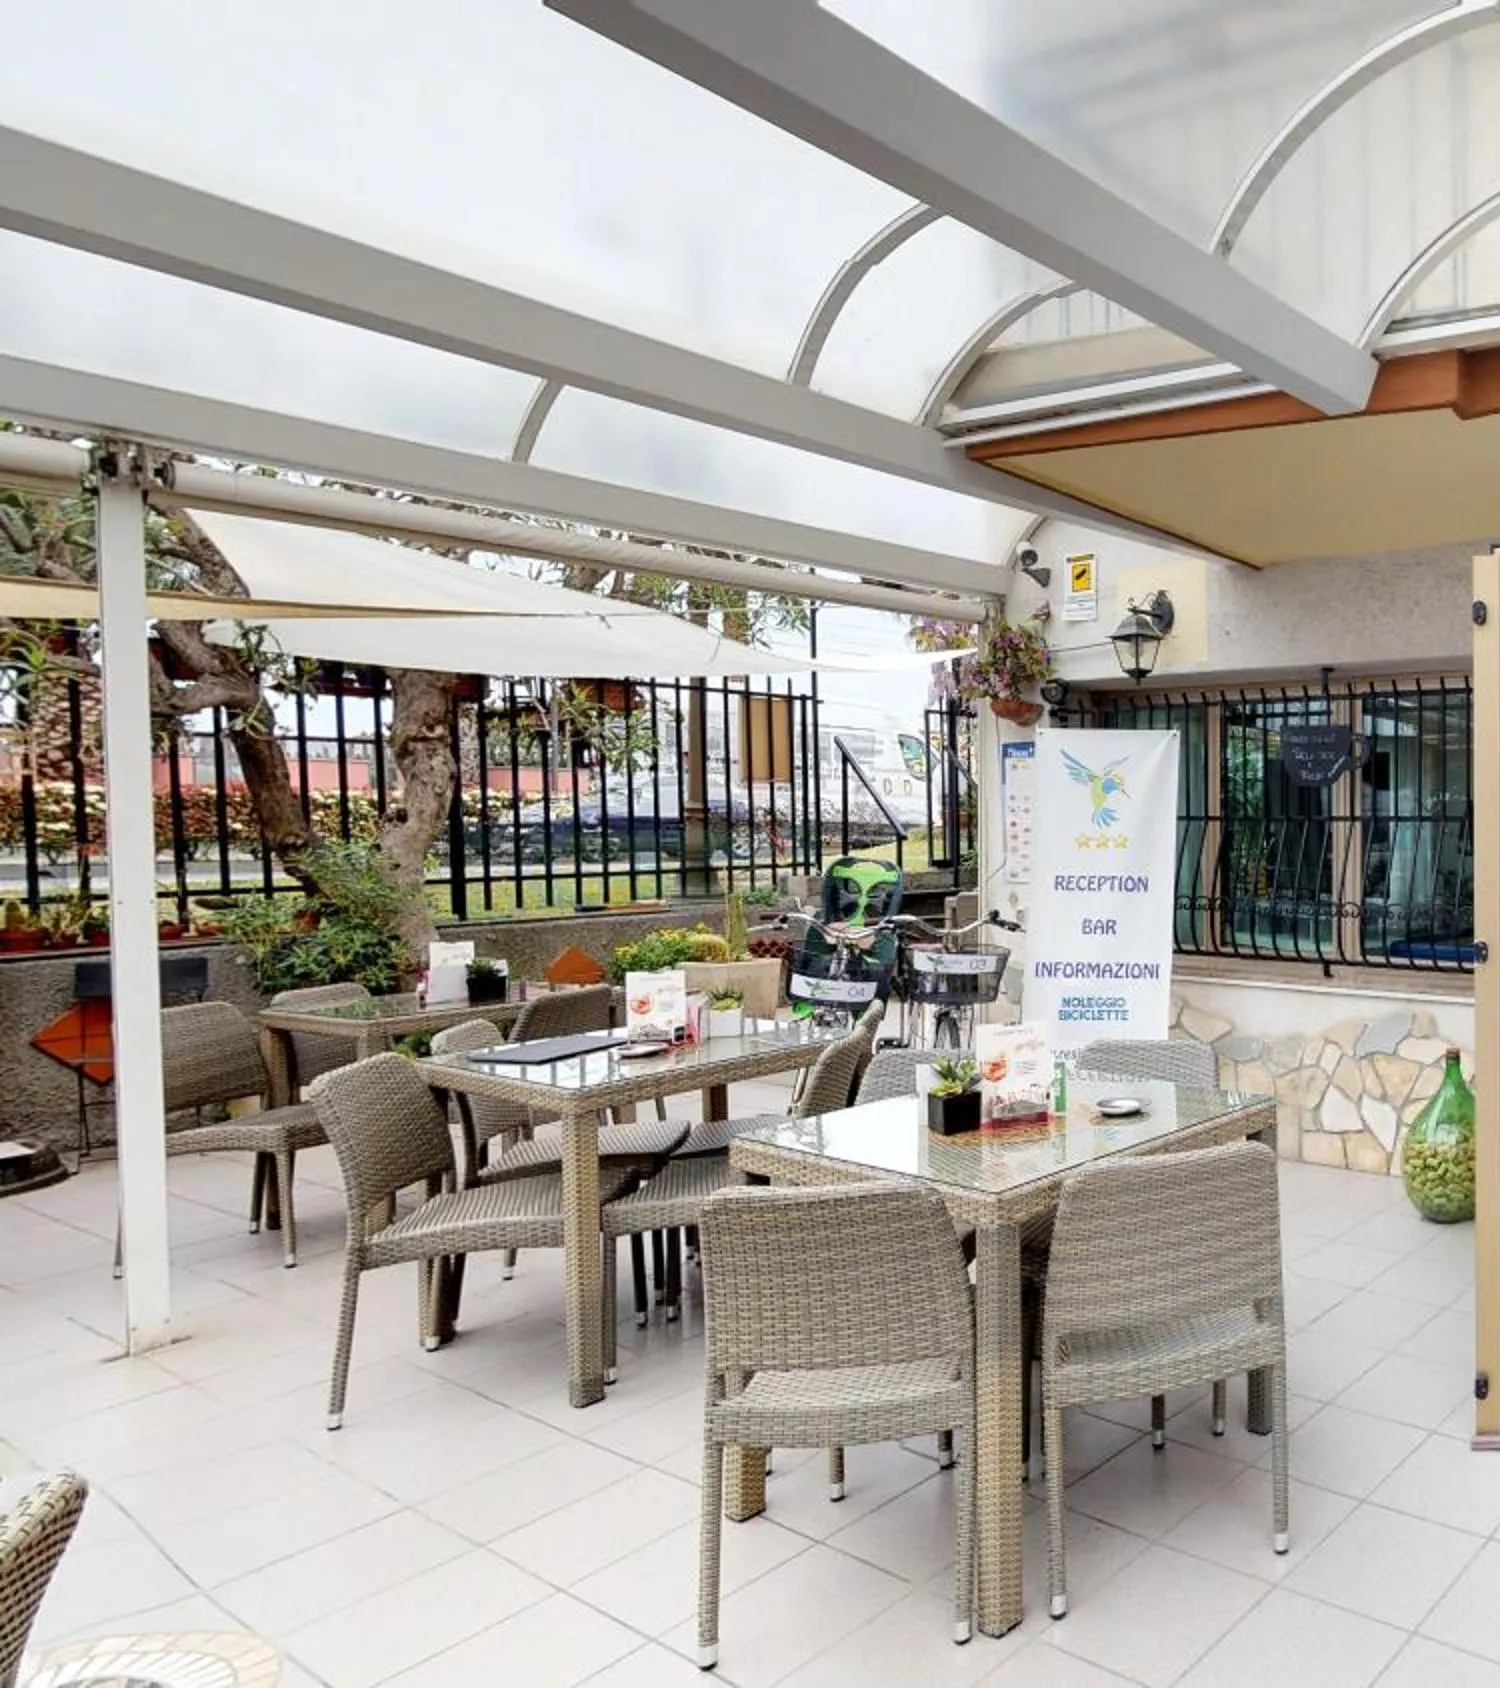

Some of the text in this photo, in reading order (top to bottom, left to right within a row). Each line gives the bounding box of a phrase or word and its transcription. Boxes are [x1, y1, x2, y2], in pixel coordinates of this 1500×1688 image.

[1054, 875, 1149, 893] RECEPTION
[1082, 918, 1117, 935] BAR
[1035, 961, 1160, 980] INFORMAZIONI
[1061, 996, 1127, 1009] NOLEGGIO
[1058, 1008, 1129, 1021] BICICLETTE
